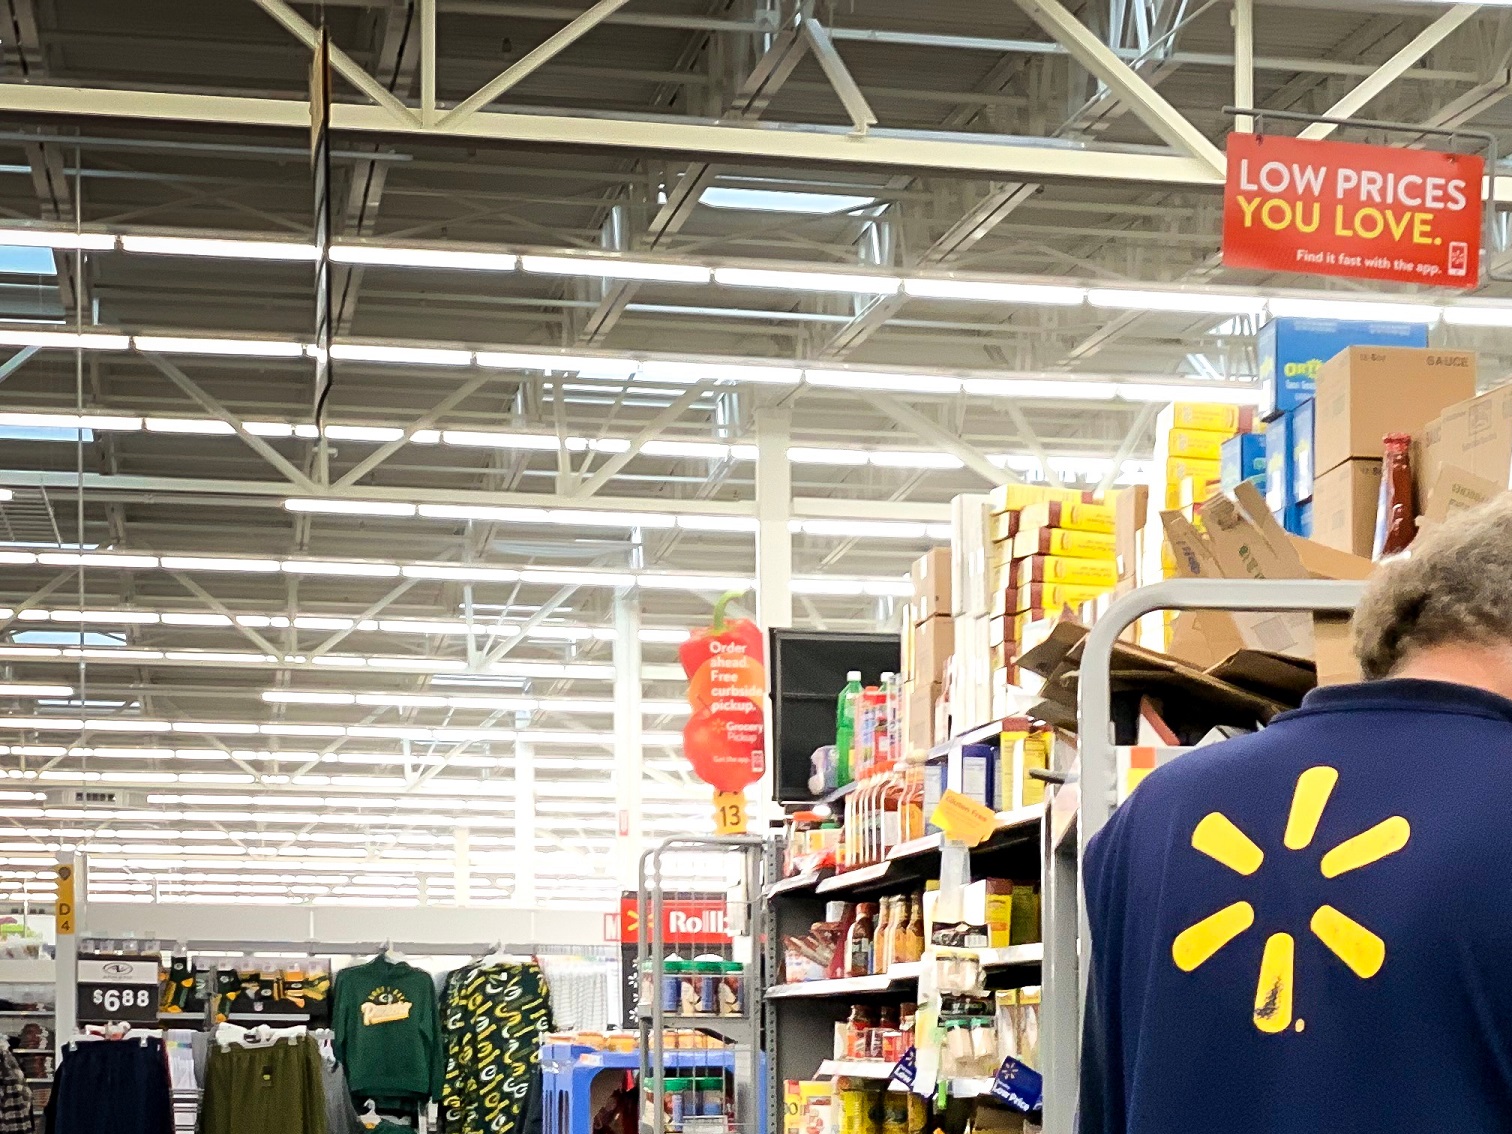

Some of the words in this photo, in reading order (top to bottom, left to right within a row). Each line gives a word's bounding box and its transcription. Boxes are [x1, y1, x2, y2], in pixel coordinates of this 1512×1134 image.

[1239, 158, 1327, 197] LOW
[1336, 167, 1467, 211] PRICES
[1236, 195, 1321, 233] YOU
[1334, 204, 1442, 246] LOVE.
[1296, 249, 1324, 262] Find
[1325, 251, 1335, 264] it
[1338, 253, 1362, 267] fast
[1364, 256, 1392, 269] with
[1393, 258, 1414, 273] the
[1415, 262, 1443, 276] app.
[1426, 355, 1469, 367] SAUCE
[709, 641, 747, 653] Order
[710, 670, 738, 682] Free
[711, 686, 763, 696] curbside
[710, 700, 756, 713] pickup.
[726, 722, 763, 733] Grocery
[720, 804, 740, 827] 13
[59, 901, 71, 916] D
[61, 920, 69, 932] 4
[669, 910, 729, 933] Roll
[1008, 1093, 1030, 1112] Price
